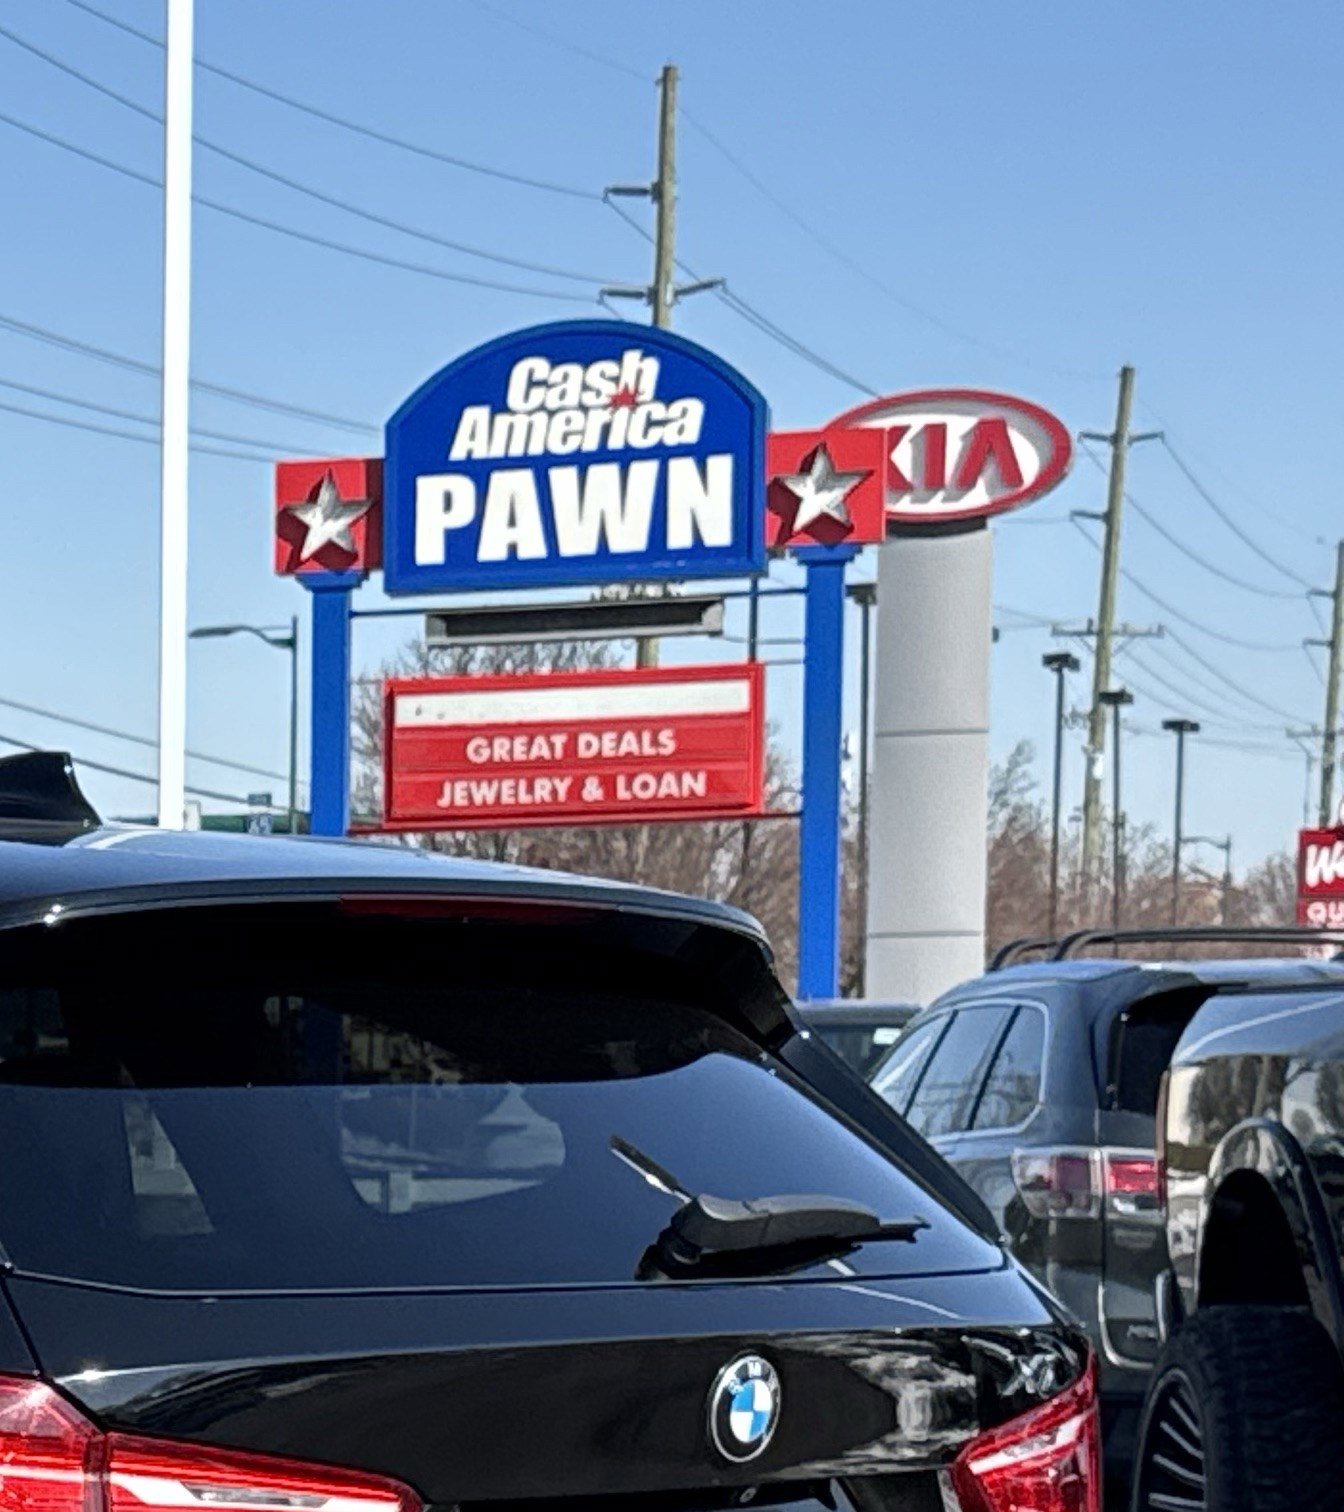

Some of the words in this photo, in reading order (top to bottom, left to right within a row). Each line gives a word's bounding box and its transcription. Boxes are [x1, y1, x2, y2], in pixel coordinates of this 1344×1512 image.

[505, 349, 660, 413] Cash
[448, 396, 705, 462] America
[415, 453, 733, 567] PAWN
[466, 733, 567, 764] GREAT
[576, 728, 677, 759] DEALS
[437, 776, 572, 808] JEWELRY
[580, 775, 605, 802] &
[615, 769, 708, 801] LOAN
